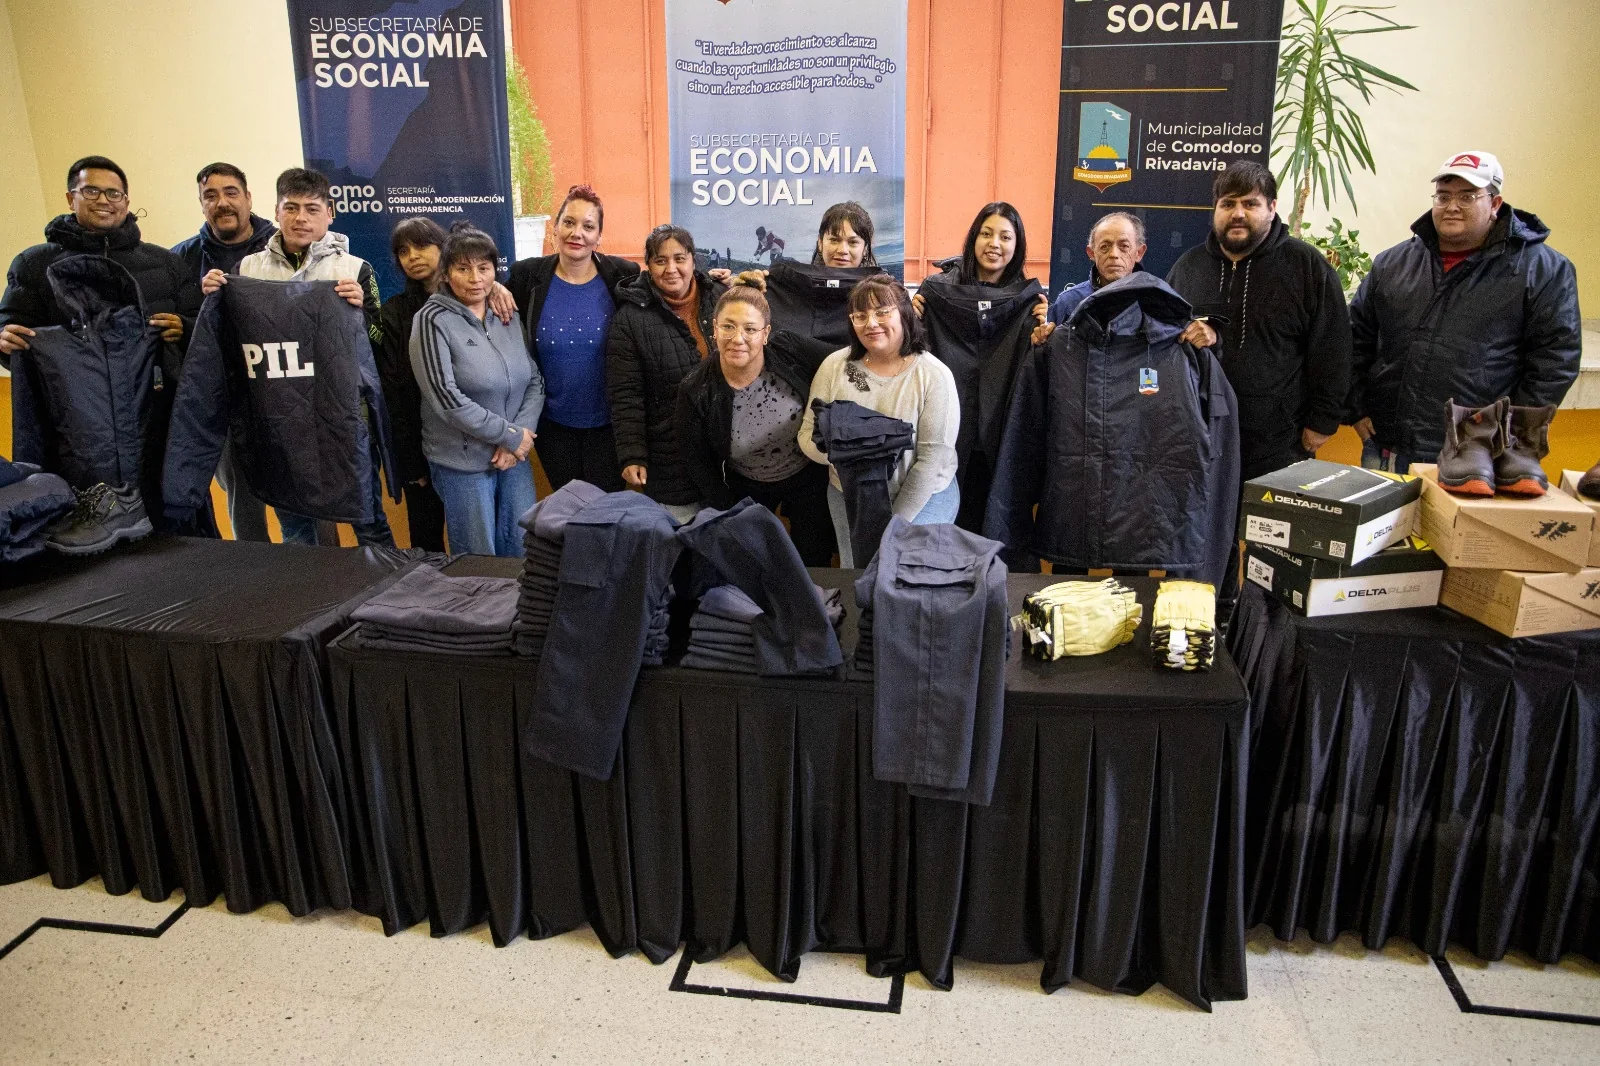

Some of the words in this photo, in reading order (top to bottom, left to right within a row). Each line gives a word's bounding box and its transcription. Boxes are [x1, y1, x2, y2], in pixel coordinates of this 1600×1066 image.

[309, 14, 454, 32] SUBSECRETARÍA
[459, 17, 484, 32] DE
[1106, 0, 1239, 33] SOCIAL
[310, 33, 488, 59] ECONOMIA
[714, 41, 763, 56] verdadero
[764, 35, 823, 52] crecimiento
[824, 36, 838, 47] se
[838, 32, 877, 49] alcanza
[315, 62, 430, 88] SOCIAL
[712, 61, 728, 76] las
[729, 57, 801, 80] oportunidades
[802, 57, 815, 69] no
[816, 56, 834, 67] son
[836, 56, 848, 67] un
[849, 54, 896, 74] privilegio
[688, 79, 709, 93] sino
[711, 84, 722, 95] un
[723, 80, 763, 95] derecho
[763, 75, 810, 92] accesible
[810, 76, 833, 93] para
[690, 132, 814, 148] SUBSECRETARÍA
[818, 132, 840, 146] DE
[1148, 122, 1264, 138] Municipalidad
[1146, 140, 1167, 153] de
[1171, 140, 1263, 154] Comodoro
[690, 146, 878, 175] ECONOMIA
[1145, 157, 1227, 172] Rivadavia
[387, 185, 436, 195] SECRETARÍA
[388, 196, 433, 204] GOBIERNO,
[434, 194, 505, 204] MODERNIZACIÓN
[692, 178, 813, 206] SOCIAL
[388, 206, 394, 214] Y
[241, 341, 315, 379] PIL
[1274, 494, 1343, 515] DELTAPLUS
